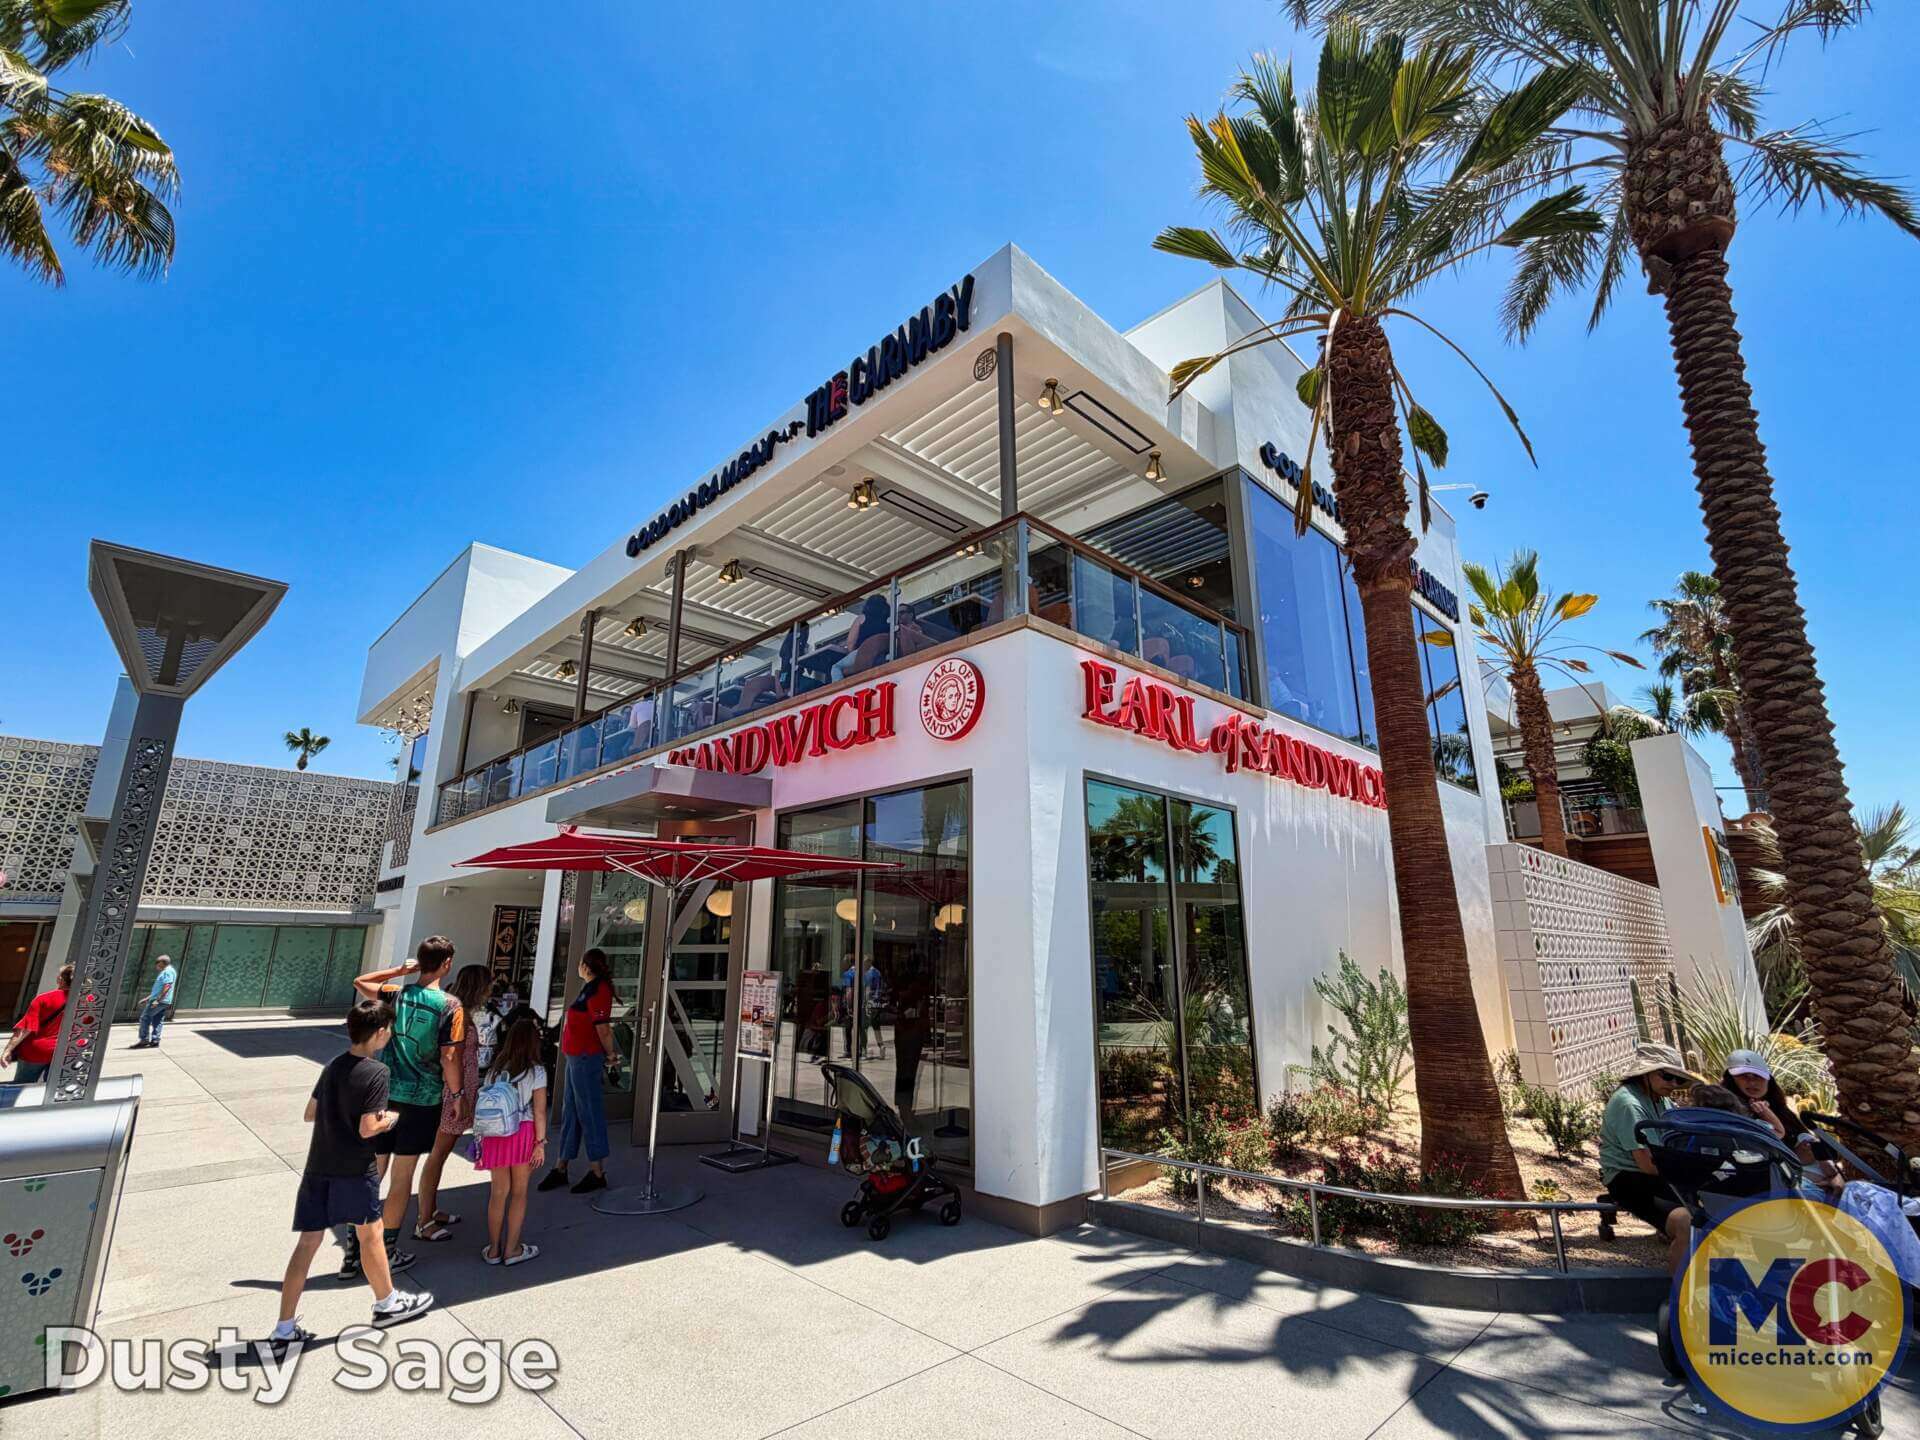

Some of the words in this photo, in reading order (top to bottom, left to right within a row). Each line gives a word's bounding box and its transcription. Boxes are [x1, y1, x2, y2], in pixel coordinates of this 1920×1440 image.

[626, 492, 697, 558] GORDON
[697, 430, 779, 509] RAMSAY
[804, 370, 849, 438] THE
[849, 273, 975, 406] CARNABY
[1260, 440, 1336, 518] GORON
[926, 661, 956, 691] EARL
[958, 664, 973, 680] OF
[923, 698, 975, 736] SANDWICH
[1080, 659, 1210, 754] EARL
[1210, 713, 1242, 774] of
